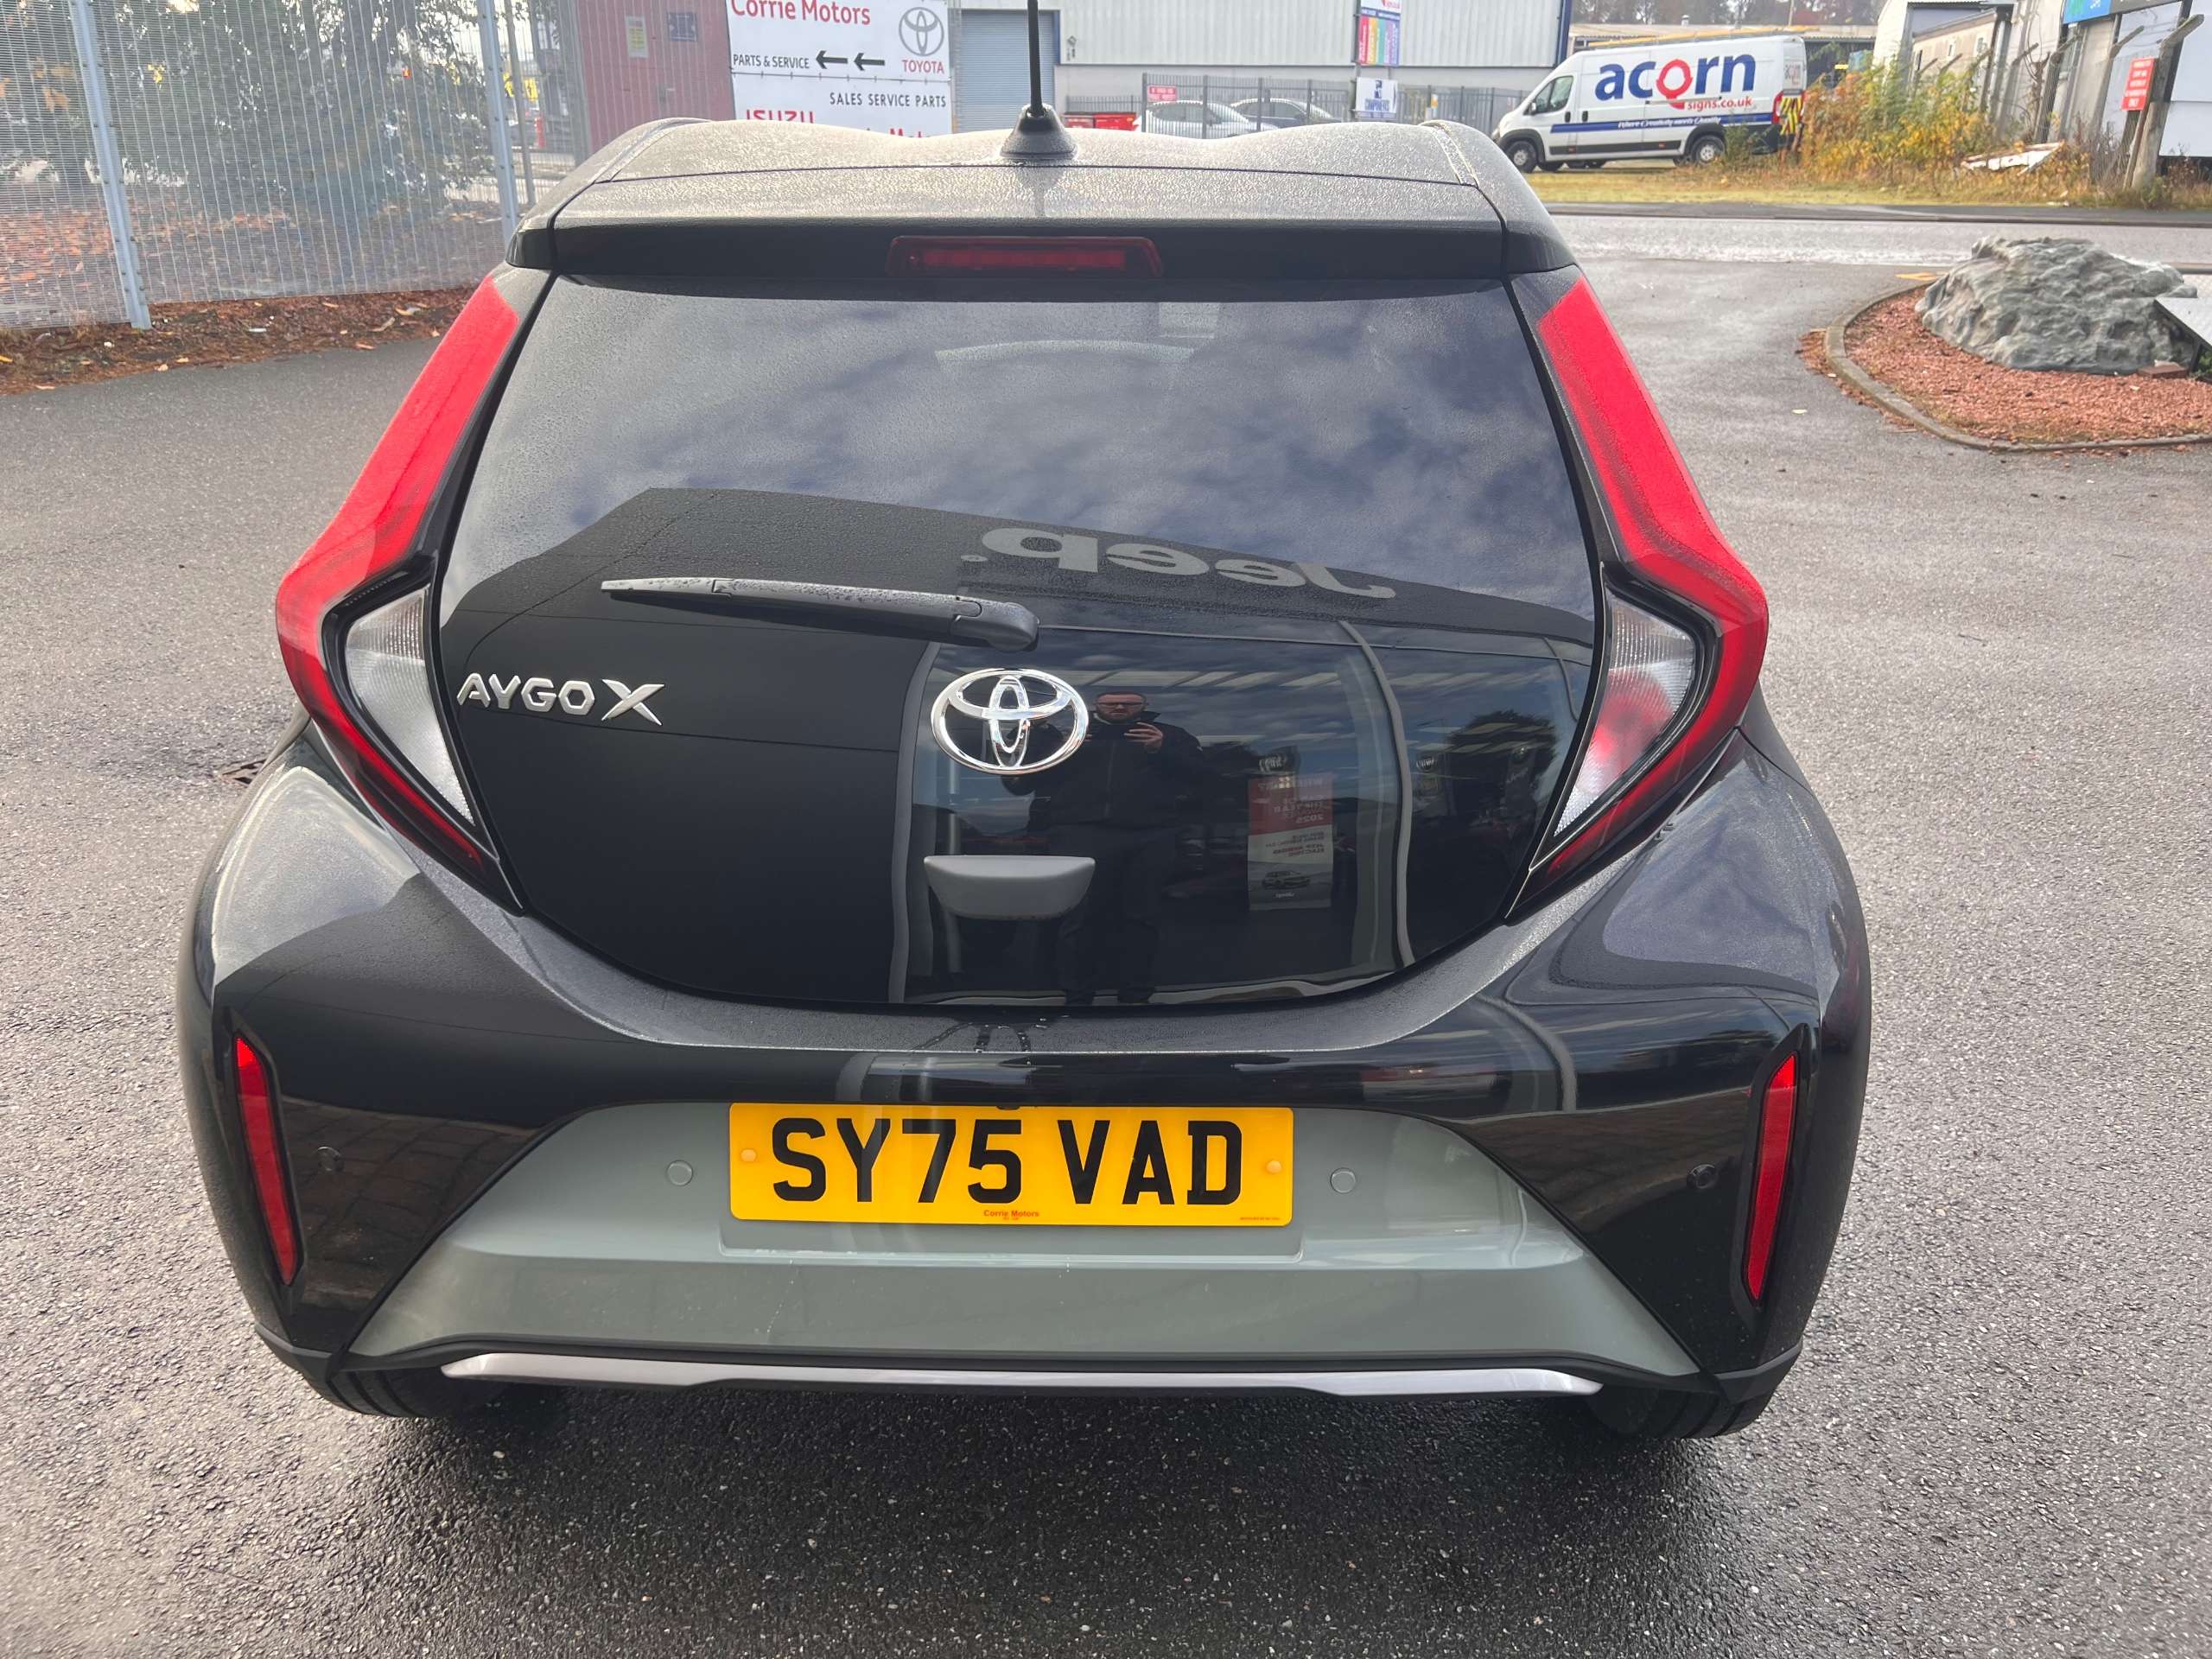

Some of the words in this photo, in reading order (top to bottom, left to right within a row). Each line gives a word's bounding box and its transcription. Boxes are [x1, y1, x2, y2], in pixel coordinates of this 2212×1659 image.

[732, 0, 796, 20] Corrie
[802, 0, 871, 25] Motors
[733, 54, 761, 67] PARTS
[763, 55, 770, 67] &
[772, 55, 810, 69] SERVICE
[902, 60, 944, 74] TOYOTA
[1595, 54, 1756, 104] acorn
[830, 92, 862, 105] SALES
[868, 93, 910, 106] SERVICE
[915, 94, 947, 107] PARTS
[1687, 95, 1752, 111] signs.co.uk
[457, 672, 594, 715] AYGO
[601, 678, 665, 726] X
[772, 1116, 1022, 1204] SY75
[1057, 1119, 1243, 1205] VAD
